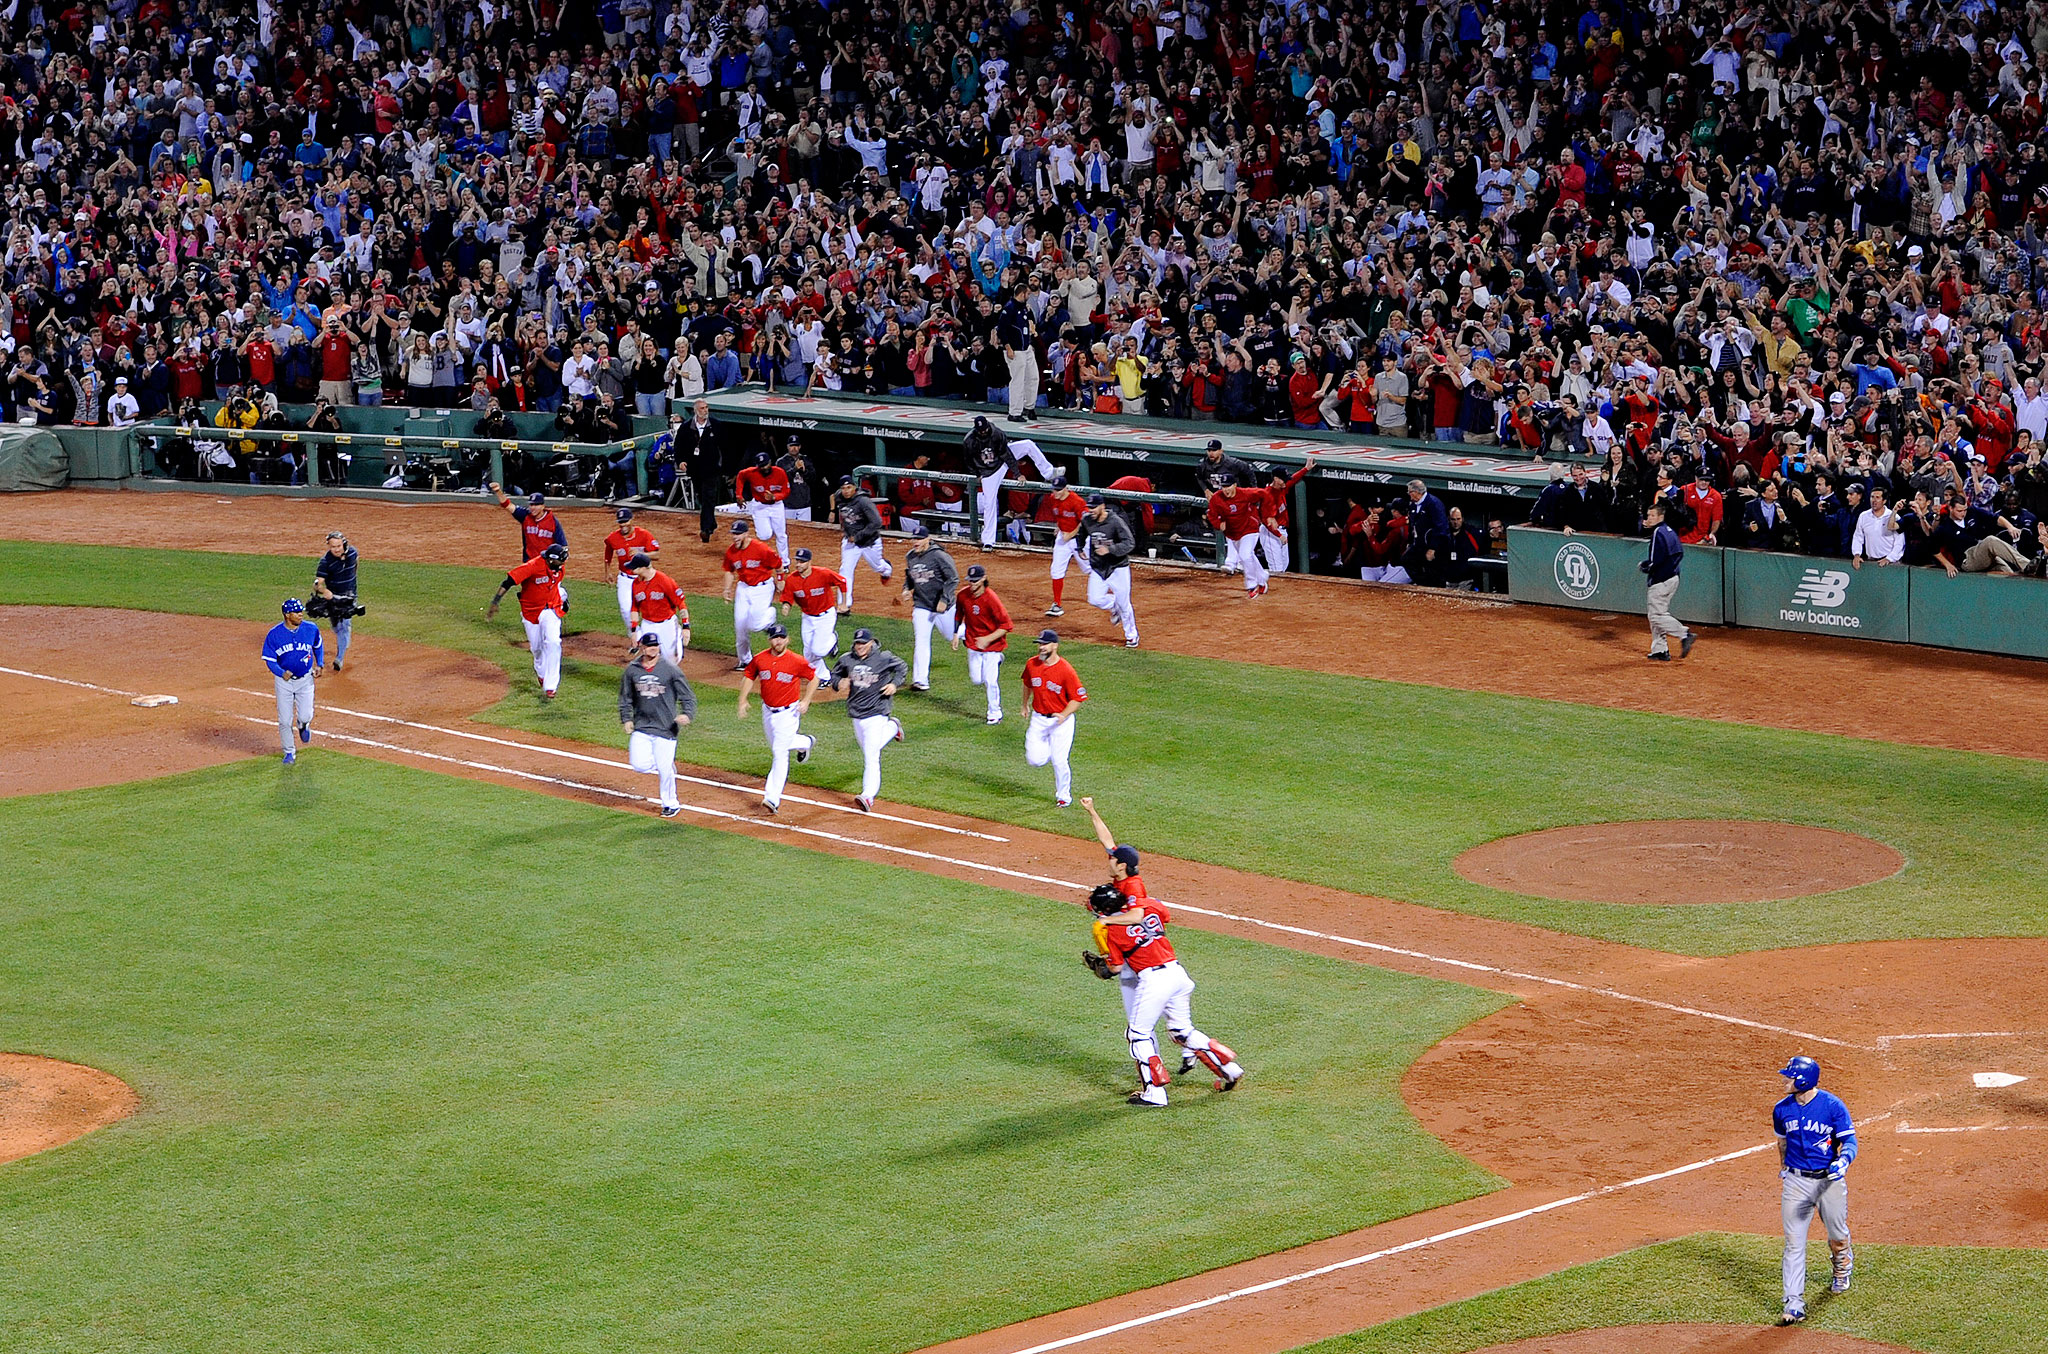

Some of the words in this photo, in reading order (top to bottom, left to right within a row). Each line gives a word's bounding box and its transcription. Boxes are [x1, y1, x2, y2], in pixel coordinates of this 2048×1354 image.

[759, 416, 772, 426] Bank
[772, 417, 780, 427] of
[780, 418, 802, 428] America
[863, 426, 877, 436] Bank
[877, 427, 885, 437] of
[884, 428, 908, 438] America
[1084, 447, 1100, 457] Bank
[1100, 448, 1108, 458] of
[1107, 450, 1134, 460] America
[1322, 468, 1338, 478] Bank
[1338, 470, 1347, 480] of
[1346, 470, 1374, 482] America
[1448, 480, 1465, 491] Bank
[1465, 482, 1474, 492] of
[1473, 483, 1502, 494] America
[1559, 549, 1568, 562] OLD
[1569, 546, 1594, 565] DOMINION
[1560, 580, 1582, 596] FREIGHT
[1780, 609, 1806, 622] new
[1808, 610, 1860, 628] balance
[275, 643, 294, 656] BLUE
[296, 643, 312, 653] JAY
